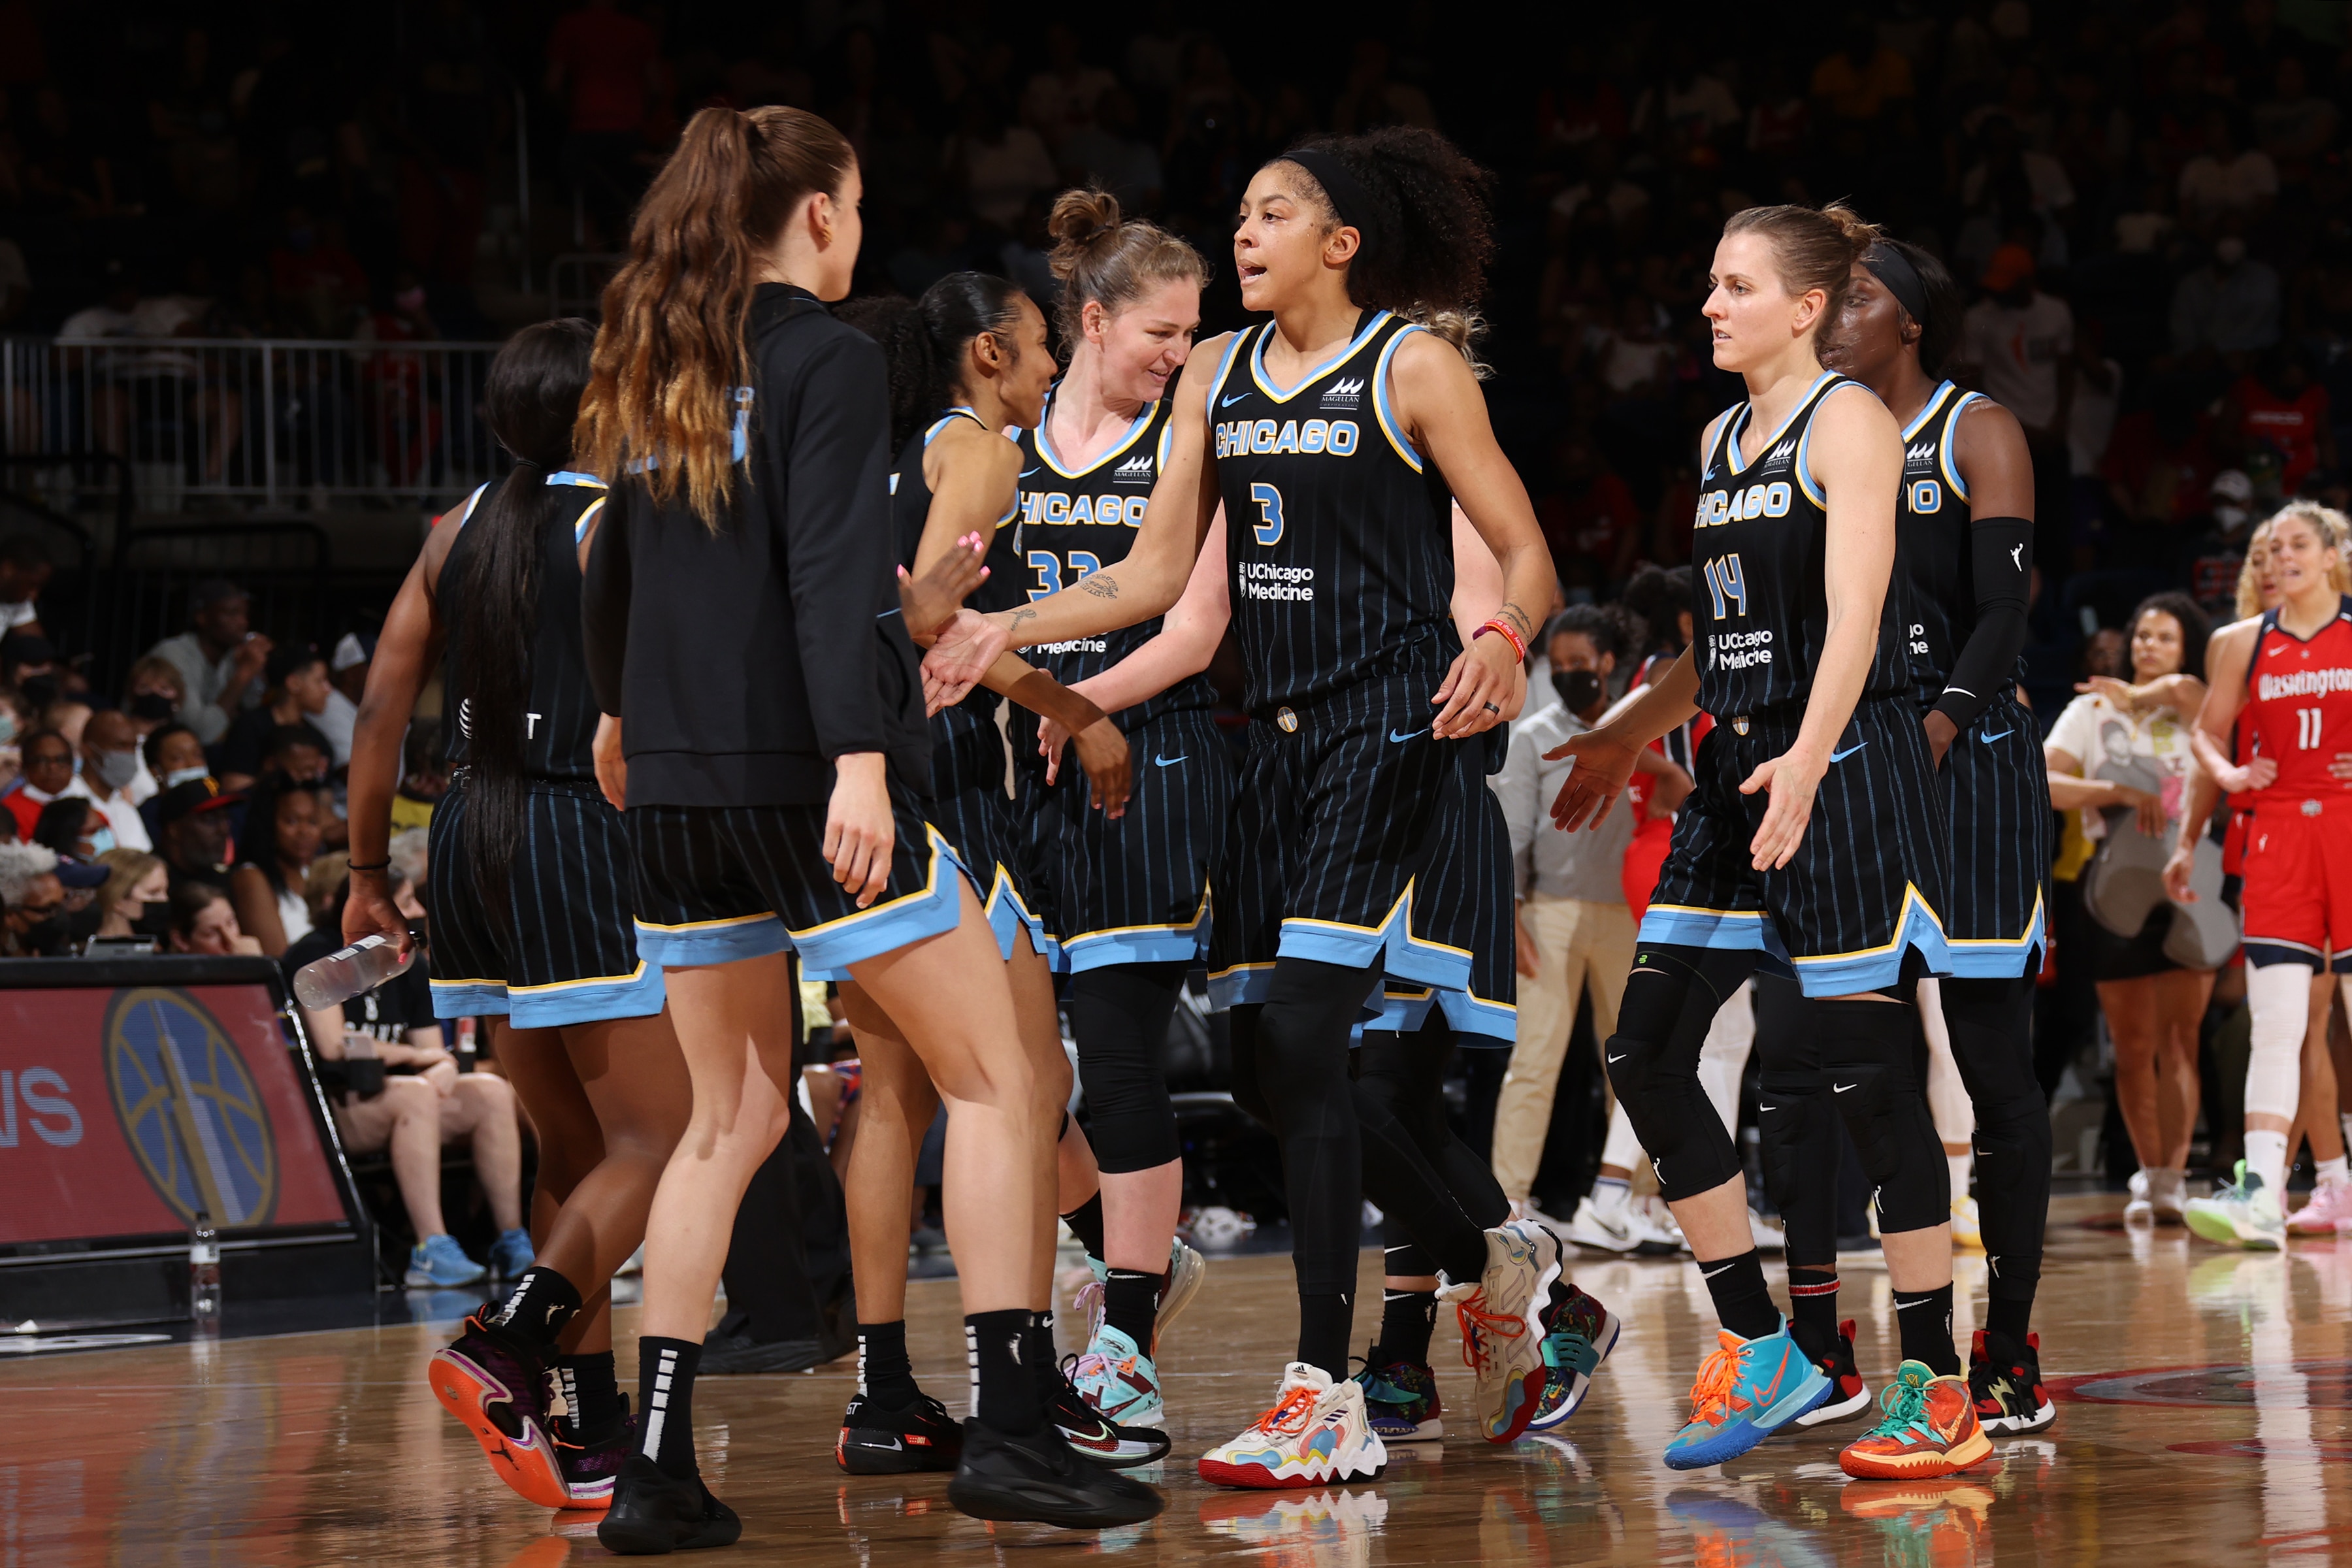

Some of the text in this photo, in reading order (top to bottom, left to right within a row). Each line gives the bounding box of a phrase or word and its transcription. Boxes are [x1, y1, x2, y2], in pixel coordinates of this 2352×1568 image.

[1216, 419, 1360, 459] CHICAGO
[1020, 491, 1149, 528] HICAGO
[1250, 482, 1284, 546] 3
[1247, 563, 1315, 583] UChicago
[1248, 582, 1314, 601] Medicine
[1703, 553, 1746, 621] 14
[2296, 708, 2322, 750] 11
